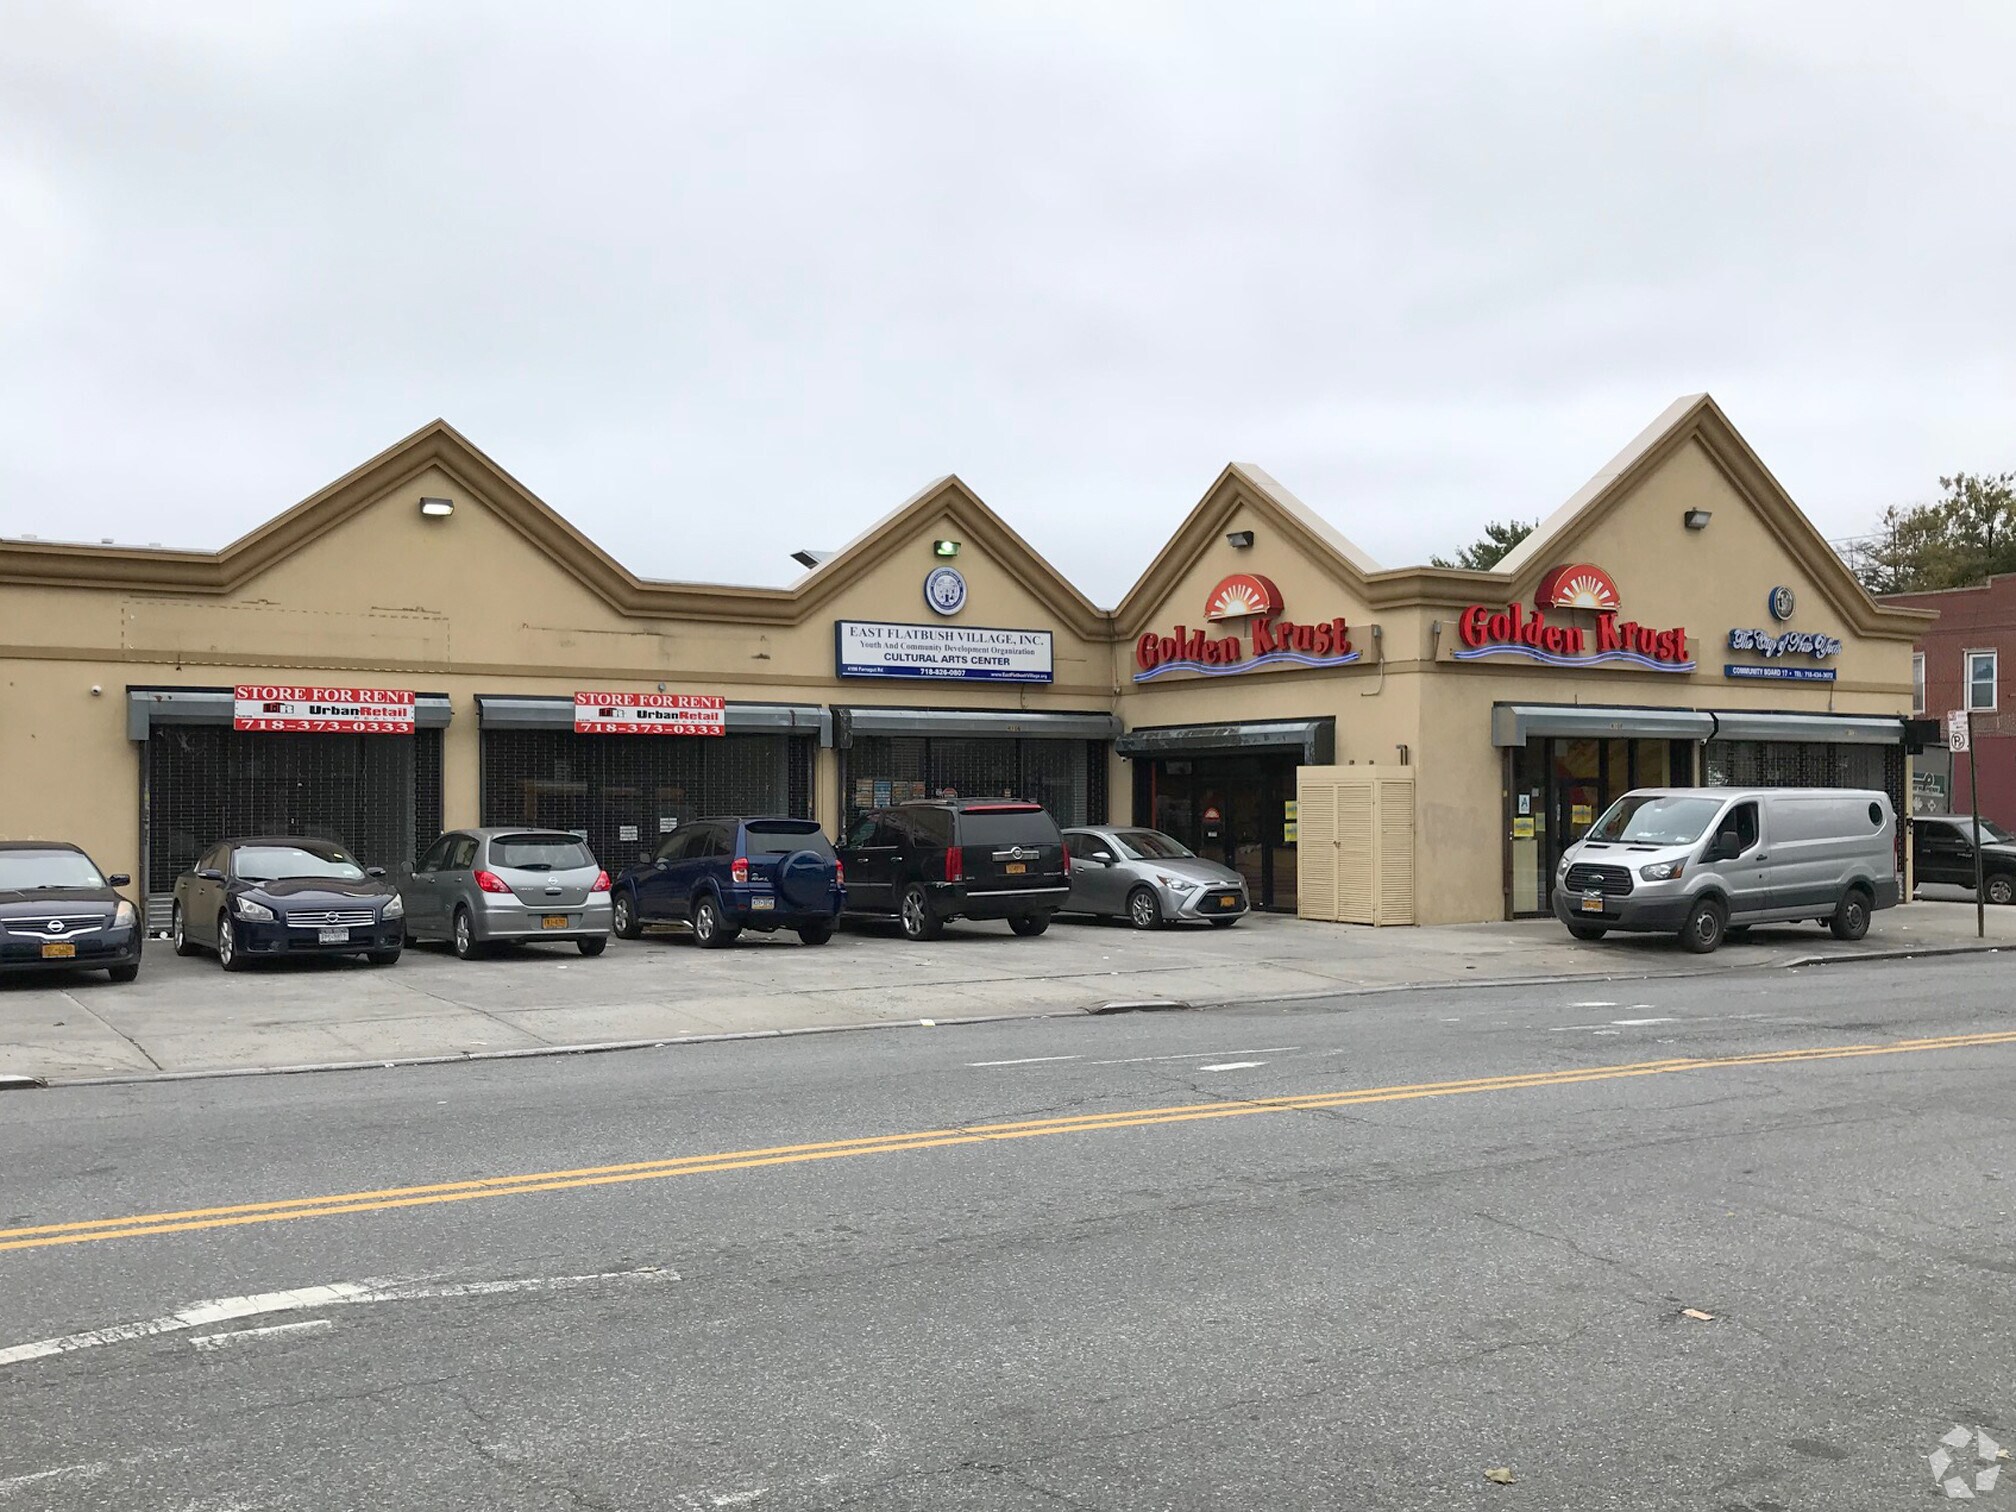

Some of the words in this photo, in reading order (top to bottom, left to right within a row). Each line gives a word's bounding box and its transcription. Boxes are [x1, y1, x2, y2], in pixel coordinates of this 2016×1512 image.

[849, 626, 884, 638] EAST
[887, 628, 954, 641] FLATBUSH
[1019, 634, 1044, 646] INC.
[1458, 602, 1585, 654] Golden
[1595, 612, 1689, 662] Krust
[860, 640, 882, 649] Youth
[884, 641, 899, 650] And
[900, 642, 942, 653] Community
[944, 644, 989, 656] Development
[991, 646, 1035, 656] Organization
[1136, 625, 1241, 670] Golden
[1251, 617, 1352, 656] Krust
[884, 652, 939, 663] CULTURAL
[941, 654, 968, 664] ARTS
[971, 656, 1010, 666] CENTER
[1732, 667, 1763, 676] COMMUNITY
[1764, 668, 1781, 676] BOARD
[237, 686, 307, 700] STORE
[313, 688, 353, 702] FOR
[359, 690, 414, 704] RENT
[576, 693, 635, 705] STORE
[640, 695, 674, 707] FOR
[678, 696, 723, 708] RENT
[309, 705, 408, 717] UrbanRetail
[636, 709, 719, 721] UrbanRetail
[241, 720, 409, 732] 718-373-0333
[581, 723, 720, 734] 718-373-0333
